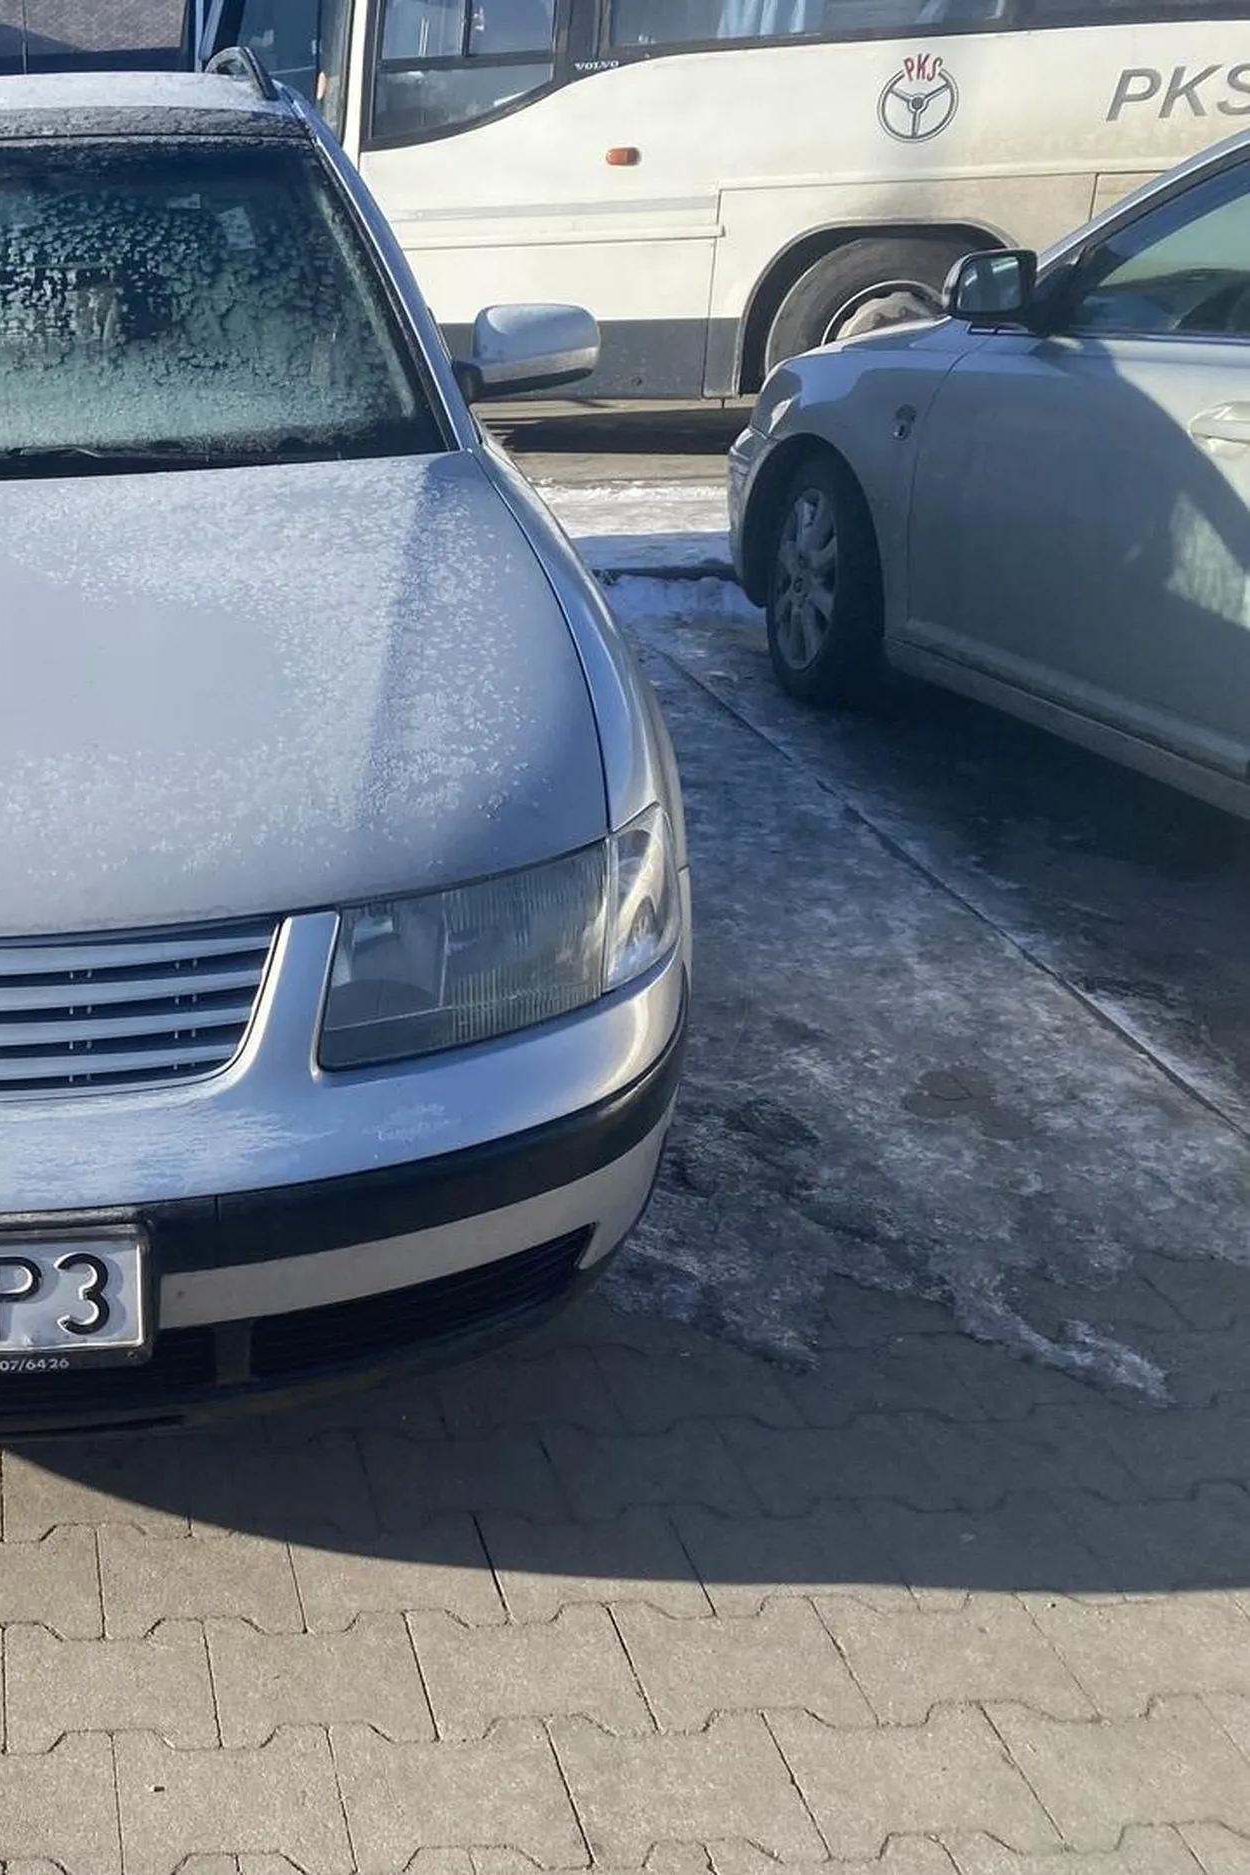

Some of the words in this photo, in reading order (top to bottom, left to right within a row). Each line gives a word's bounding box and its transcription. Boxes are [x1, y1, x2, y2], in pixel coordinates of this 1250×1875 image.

[574, 61, 620, 70] VOLVO
[903, 53, 943, 82] PKS
[1106, 62, 1250, 122] PKS
